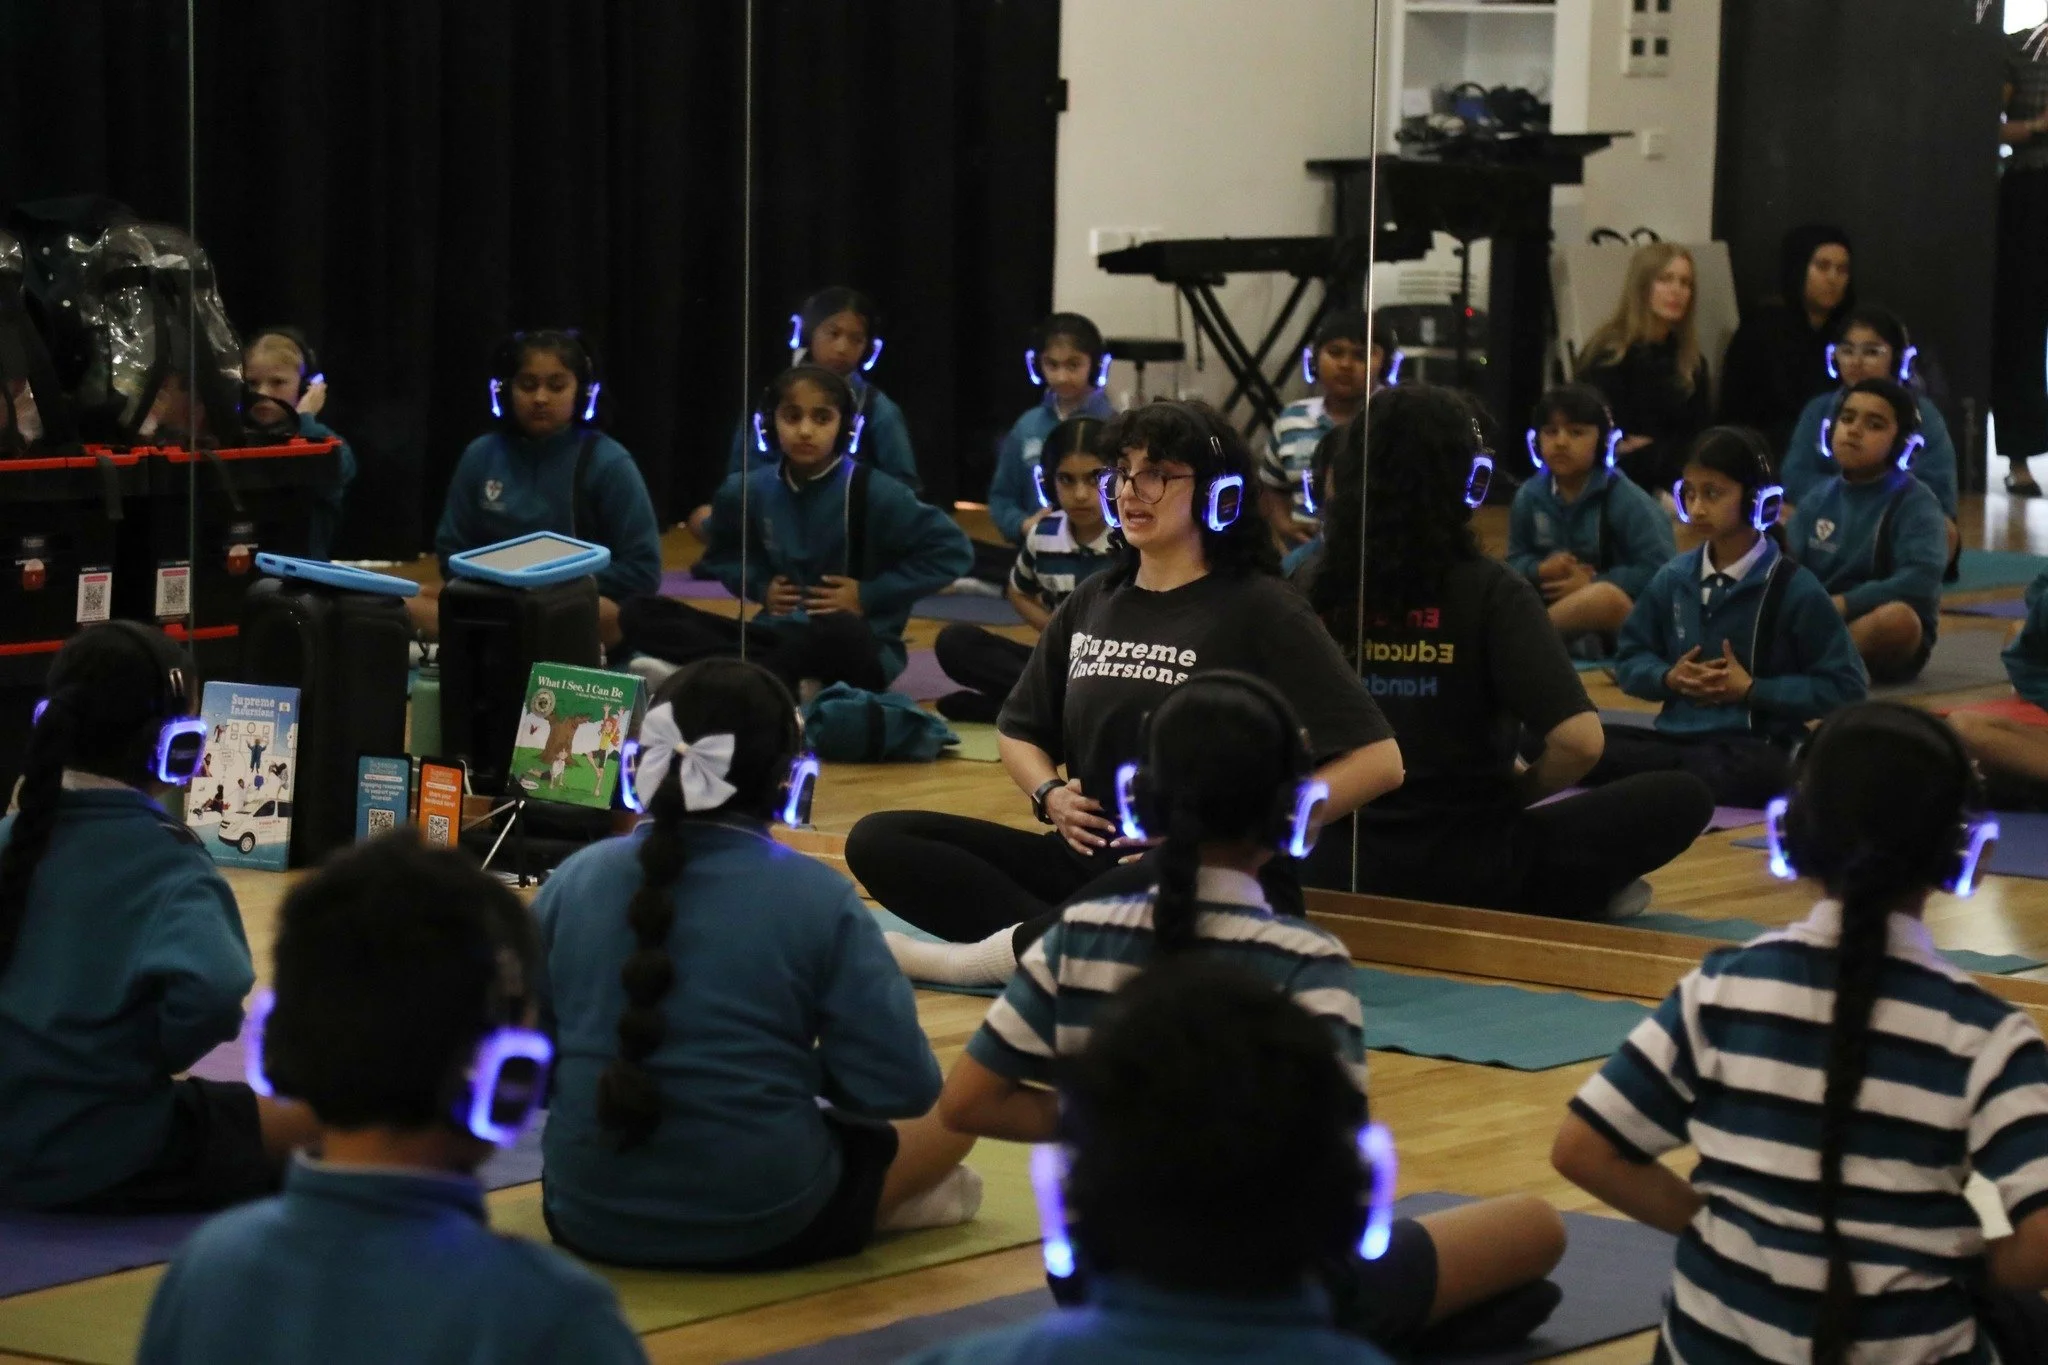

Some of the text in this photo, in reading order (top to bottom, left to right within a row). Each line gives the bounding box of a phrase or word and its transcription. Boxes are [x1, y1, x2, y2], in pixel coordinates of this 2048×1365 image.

[1078, 634, 1197, 667] Supreme
[1071, 657, 1190, 685] Incursions
[539, 675, 561, 689] What
[562, 679, 568, 689] I
[568, 680, 585, 693] See,
[586, 683, 592, 693] I
[592, 684, 609, 697] Can
[611, 685, 624, 699] Be
[231, 705, 275, 718] Incursions
[232, 693, 276, 708] Supreme
